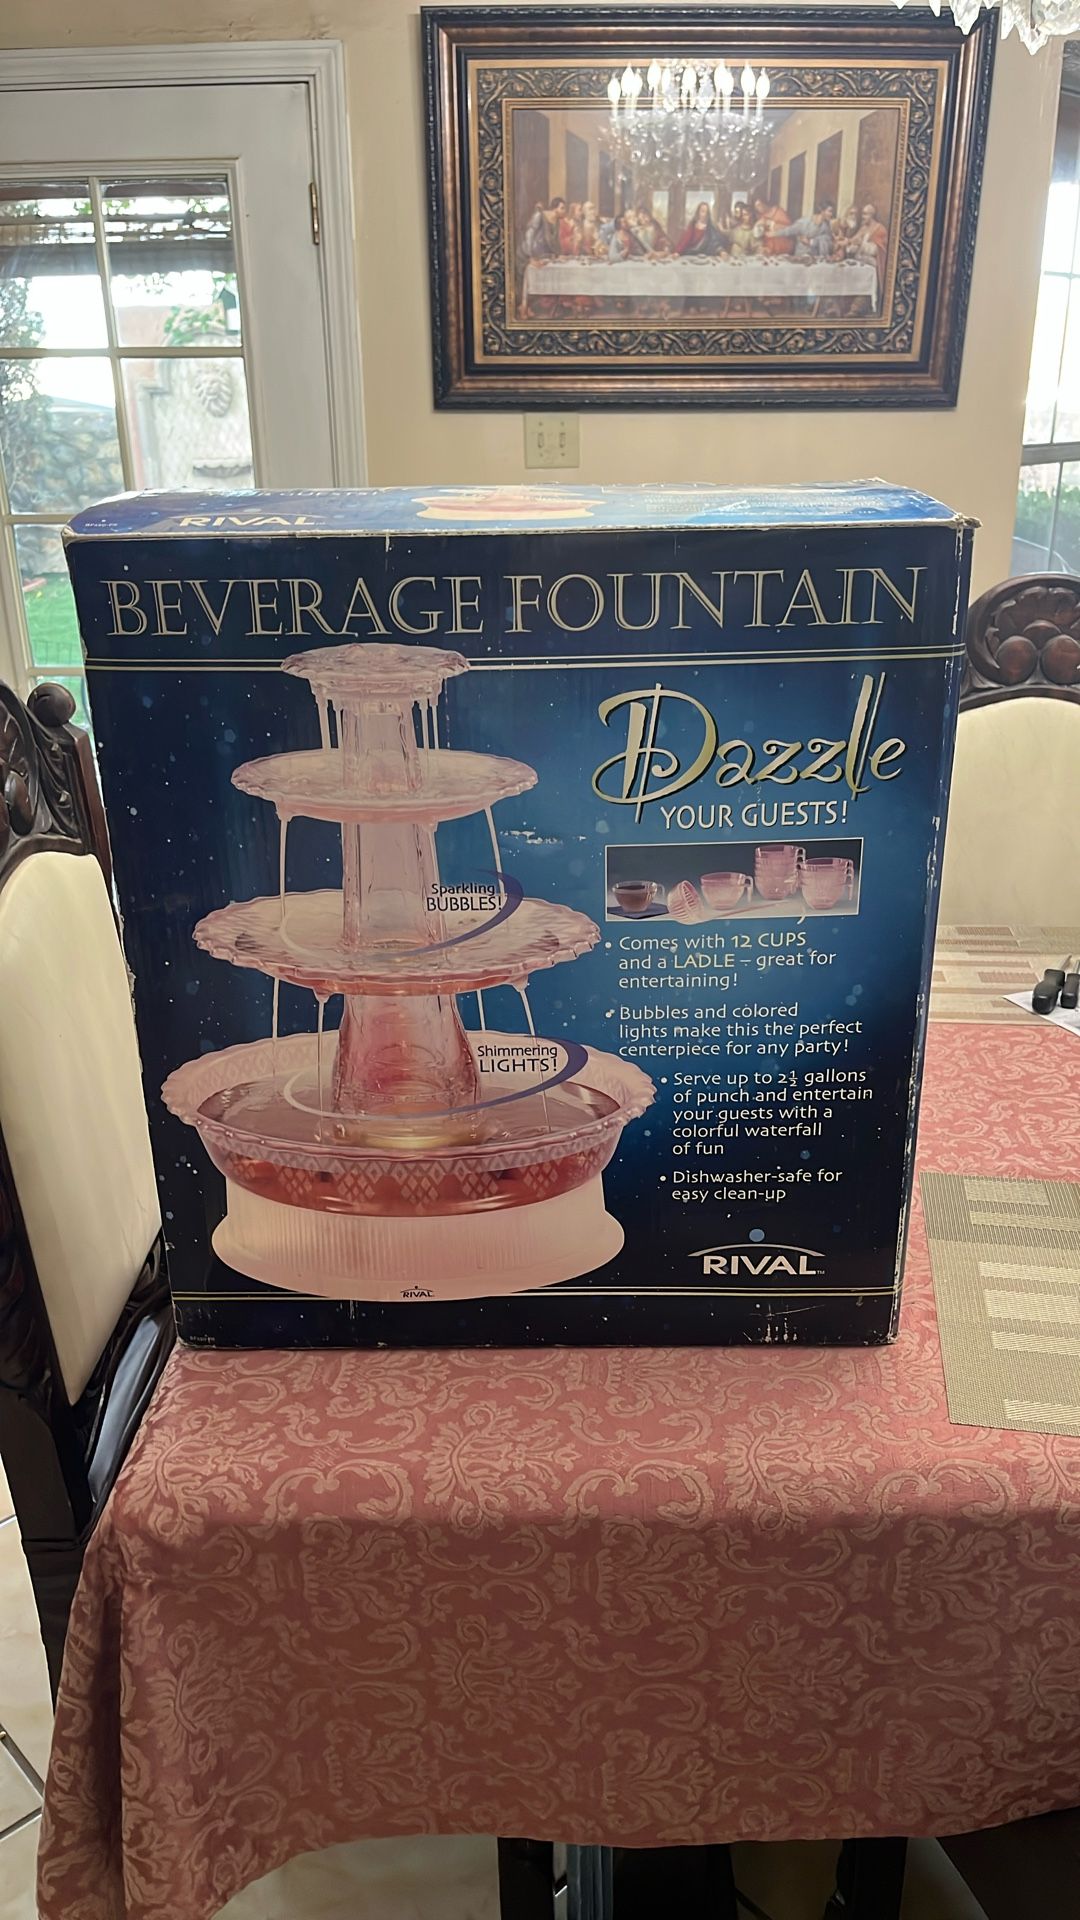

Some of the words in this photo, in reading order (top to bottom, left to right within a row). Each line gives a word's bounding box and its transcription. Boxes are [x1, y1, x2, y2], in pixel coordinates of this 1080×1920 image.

[179, 516, 315, 527] RIVAL
[101, 576, 484, 636] BEVERAGE
[503, 566, 928, 633] FOUNTAIN
[591, 672, 906, 824] Dazzle
[660, 805, 734, 830] YOUR
[741, 800, 848, 827] GUESTS!
[432, 883, 495, 897] Sparkling
[427, 896, 502, 911] BUBBLES!
[619, 936, 678, 950] Comes
[684, 934, 725, 949] with
[731, 935, 752, 948] 12
[758, 932, 806, 947] CUPS
[619, 955, 651, 970] and
[658, 958, 667, 968] a
[674, 954, 734, 968] LADLE
[756, 954, 804, 970] great
[810, 950, 836, 965] for
[619, 974, 738, 990] entertaining!
[620, 1005, 688, 1020] Bubbles
[695, 1004, 726, 1018] and
[732, 1002, 798, 1017] colored
[620, 1024, 668, 1041] lights
[674, 1024, 720, 1038] make
[727, 1022, 758, 1036] this
[764, 1022, 794, 1036] the
[800, 1020, 862, 1038] perfect
[478, 1044, 557, 1058] Shimmering
[619, 1043, 719, 1059] centerpiece
[726, 1041, 752, 1054] for
[756, 1042, 788, 1058] any
[795, 1039, 848, 1058] party!
[480, 1059, 557, 1072] LIGHTS!
[673, 1072, 721, 1085] Serve
[727, 1074, 749, 1087] up
[754, 1072, 772, 1084] to
[805, 1068, 866, 1086] gallons
[673, 1089, 691, 1103] of
[697, 1089, 749, 1105] punch
[755, 1088, 787, 1101] and
[792, 1087, 873, 1100] entertain
[673, 1109, 713, 1123] your
[718, 1108, 773, 1123] guests
[779, 1105, 818, 1119] with
[823, 1107, 832, 1118] a
[672, 1124, 739, 1138] colorful
[745, 1123, 822, 1137] waterfall
[672, 1143, 690, 1155] of
[696, 1142, 724, 1154] fun
[673, 1169, 812, 1183] Dishwasher-safe
[817, 1168, 843, 1182] for
[672, 1189, 708, 1203] easy
[714, 1187, 786, 1202] clean-up
[703, 1255, 816, 1275] RIVAL
